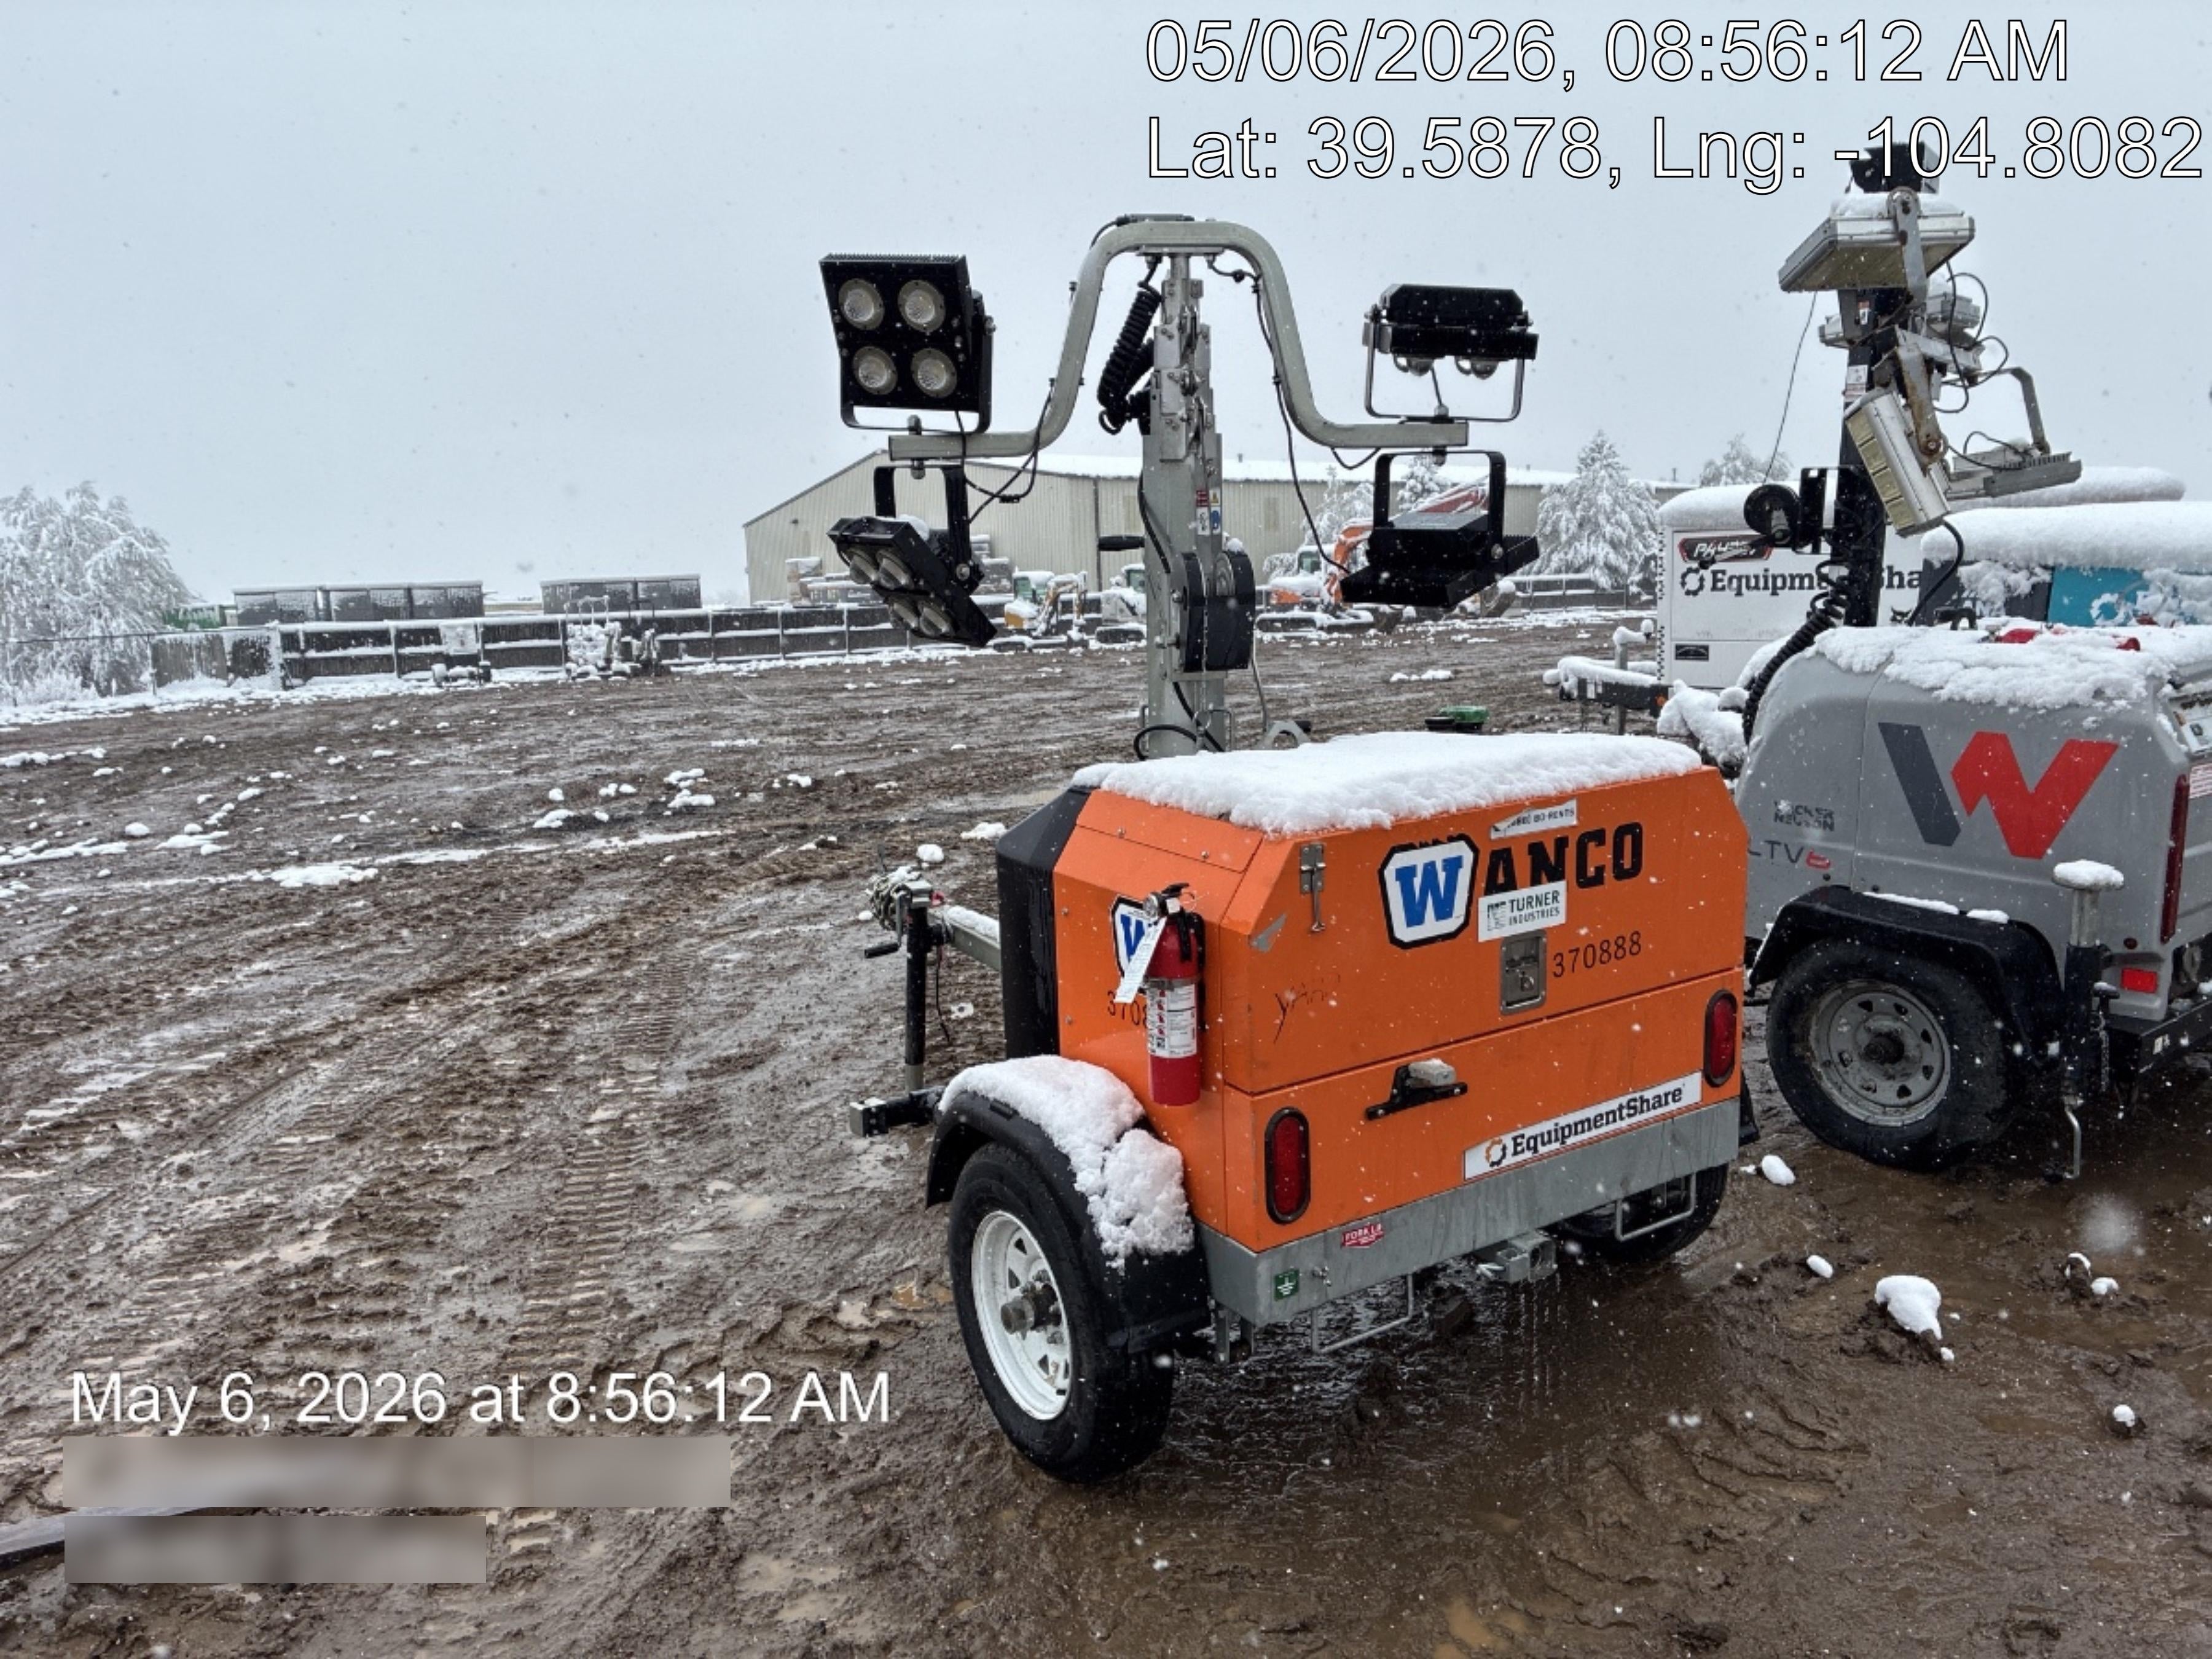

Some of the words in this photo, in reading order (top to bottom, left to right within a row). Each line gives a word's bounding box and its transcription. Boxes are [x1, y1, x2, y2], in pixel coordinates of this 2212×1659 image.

[1508, 890, 1560, 913] TURNER
[1508, 906, 1560, 926] INDUSTRIES
[1553, 931, 1642, 978] 370888
[1511, 1086, 1683, 1156] EquipmentShare
